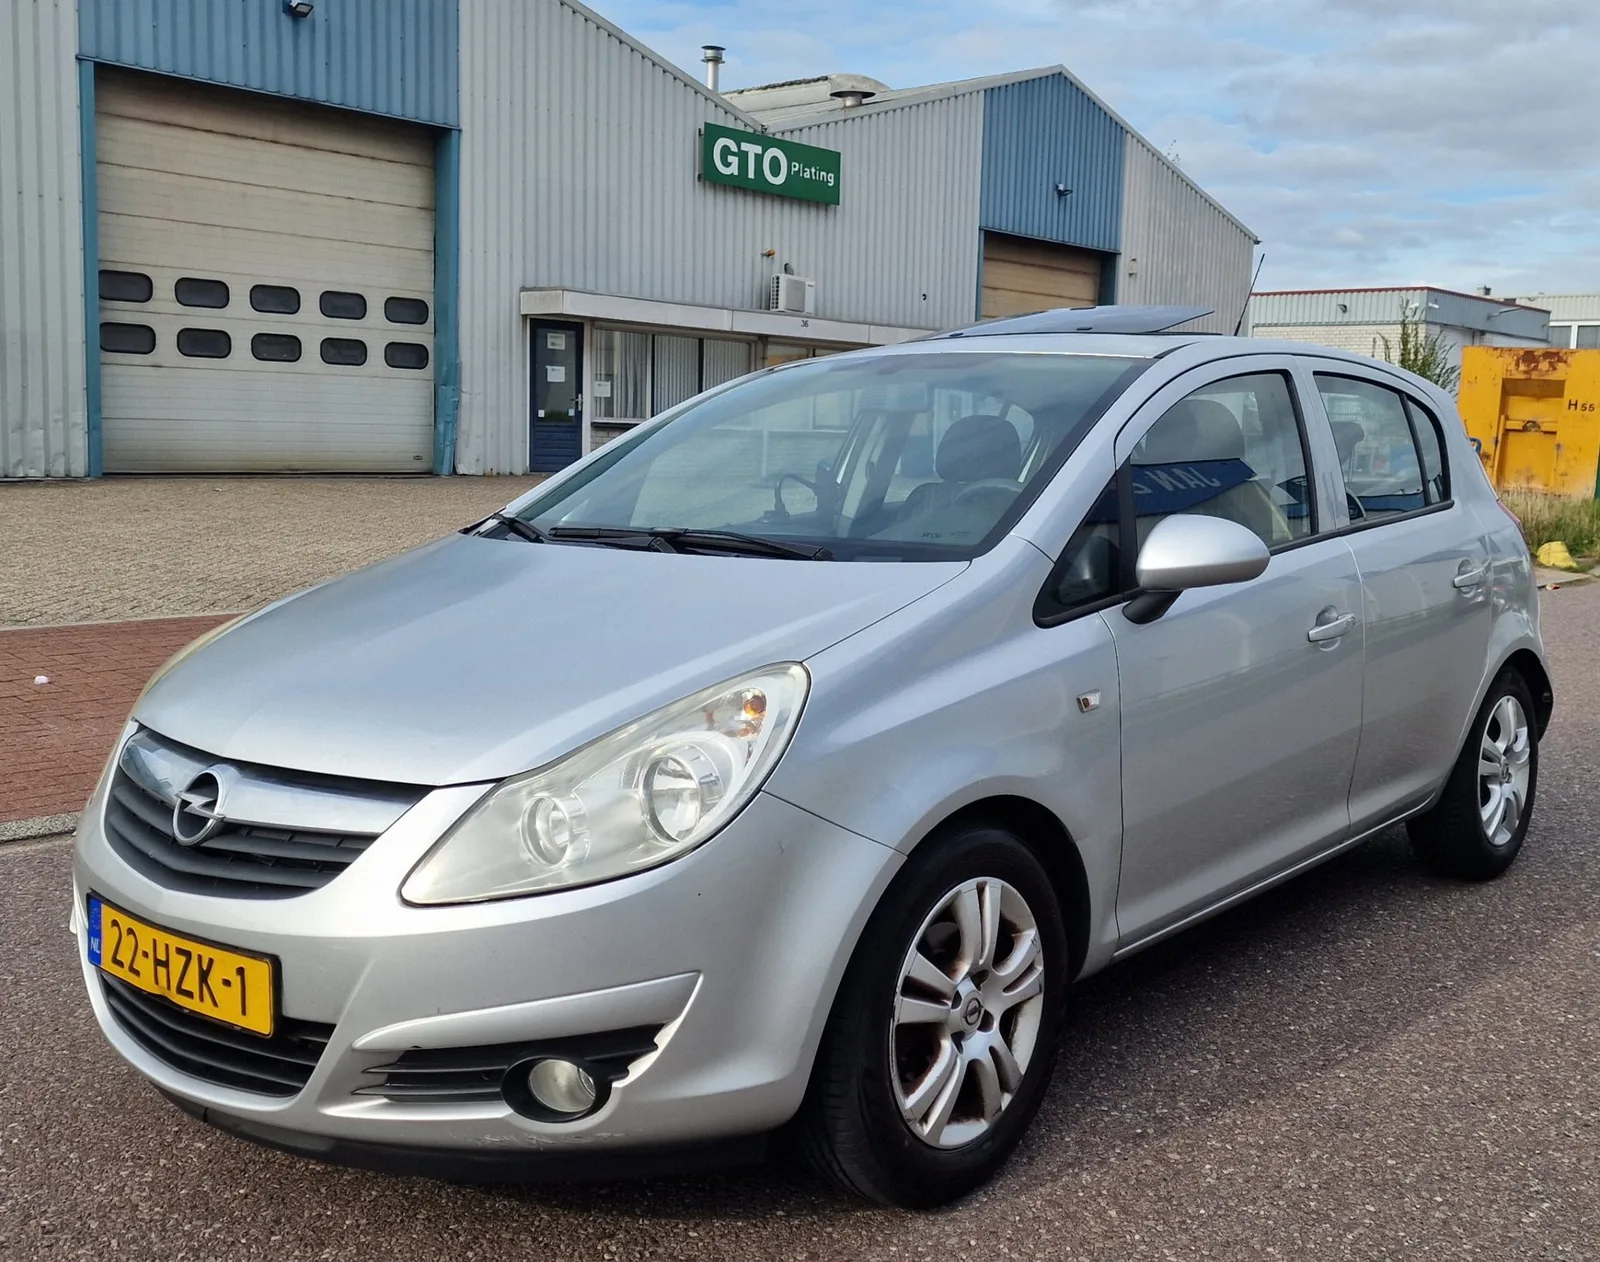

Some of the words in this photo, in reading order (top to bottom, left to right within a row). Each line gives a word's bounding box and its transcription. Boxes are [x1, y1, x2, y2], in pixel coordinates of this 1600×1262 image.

[713, 137, 788, 185] GTO
[791, 161, 835, 186] Plating
[800, 319, 809, 328] 36
[1567, 399, 1578, 411] H
[90, 936, 101, 954] NL
[110, 918, 247, 1016] 22-HZK-1
